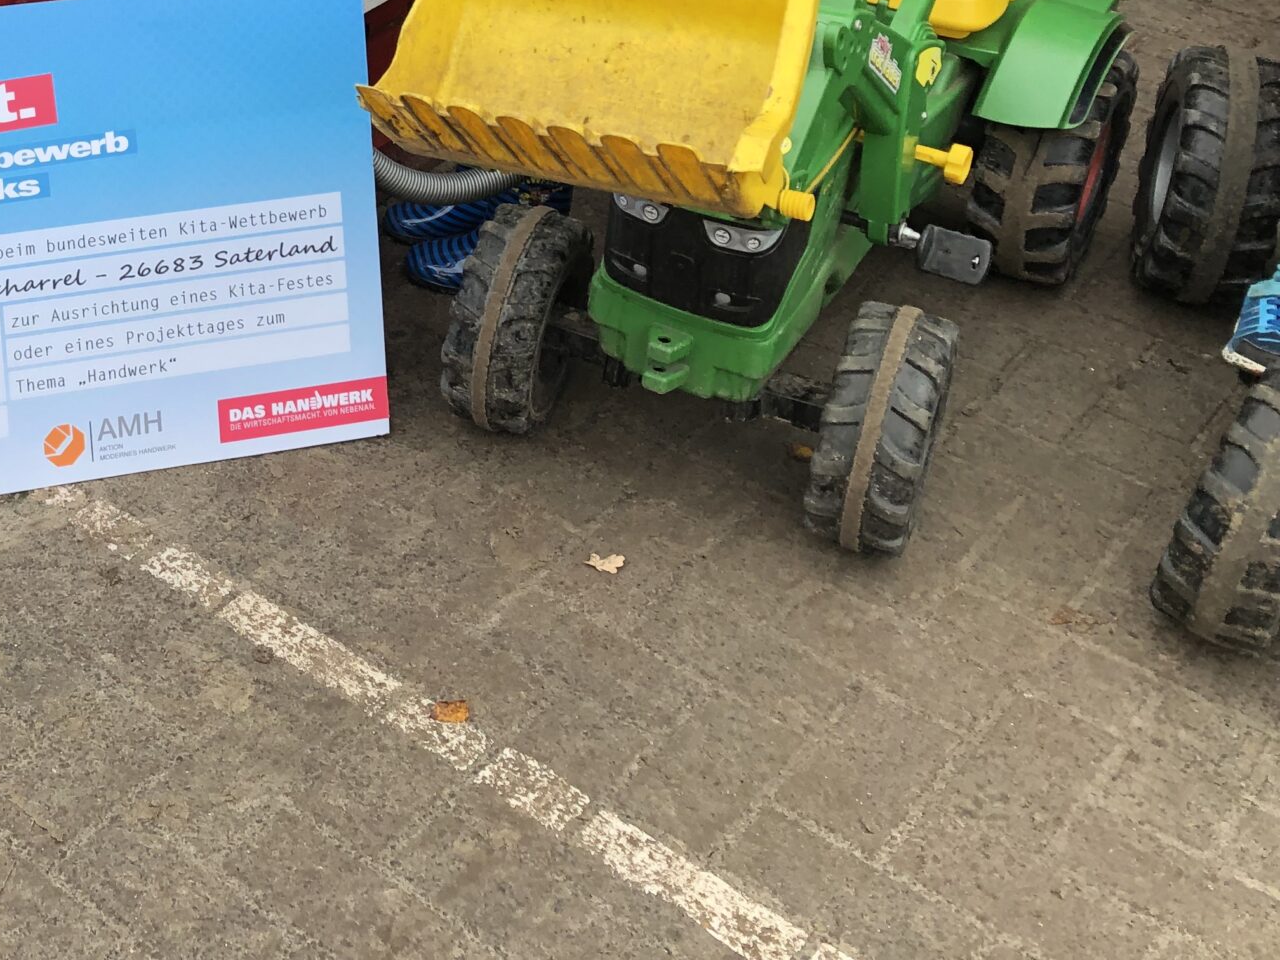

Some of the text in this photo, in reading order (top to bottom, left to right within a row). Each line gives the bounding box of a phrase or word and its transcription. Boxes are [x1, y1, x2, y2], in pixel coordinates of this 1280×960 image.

[45, 226, 168, 253] bundesweiten
[178, 203, 327, 235] Kita-Wettbewerb
[118, 254, 204, 281] 26683
[213, 234, 337, 268] Saterland
[10, 273, 333, 329] zur Ausrichtung eines Kita-Festes
[12, 312, 285, 361] oder eines Projekttages zum
[14, 375, 66, 393] Thema
[228, 387, 374, 423] DAS HANDWERK
[229, 421, 241, 431] DIE
[322, 407, 338, 416] VON
[96, 409, 163, 442] AMH
[98, 442, 124, 452] AKTION
[137, 443, 177, 455] HANDWERK
